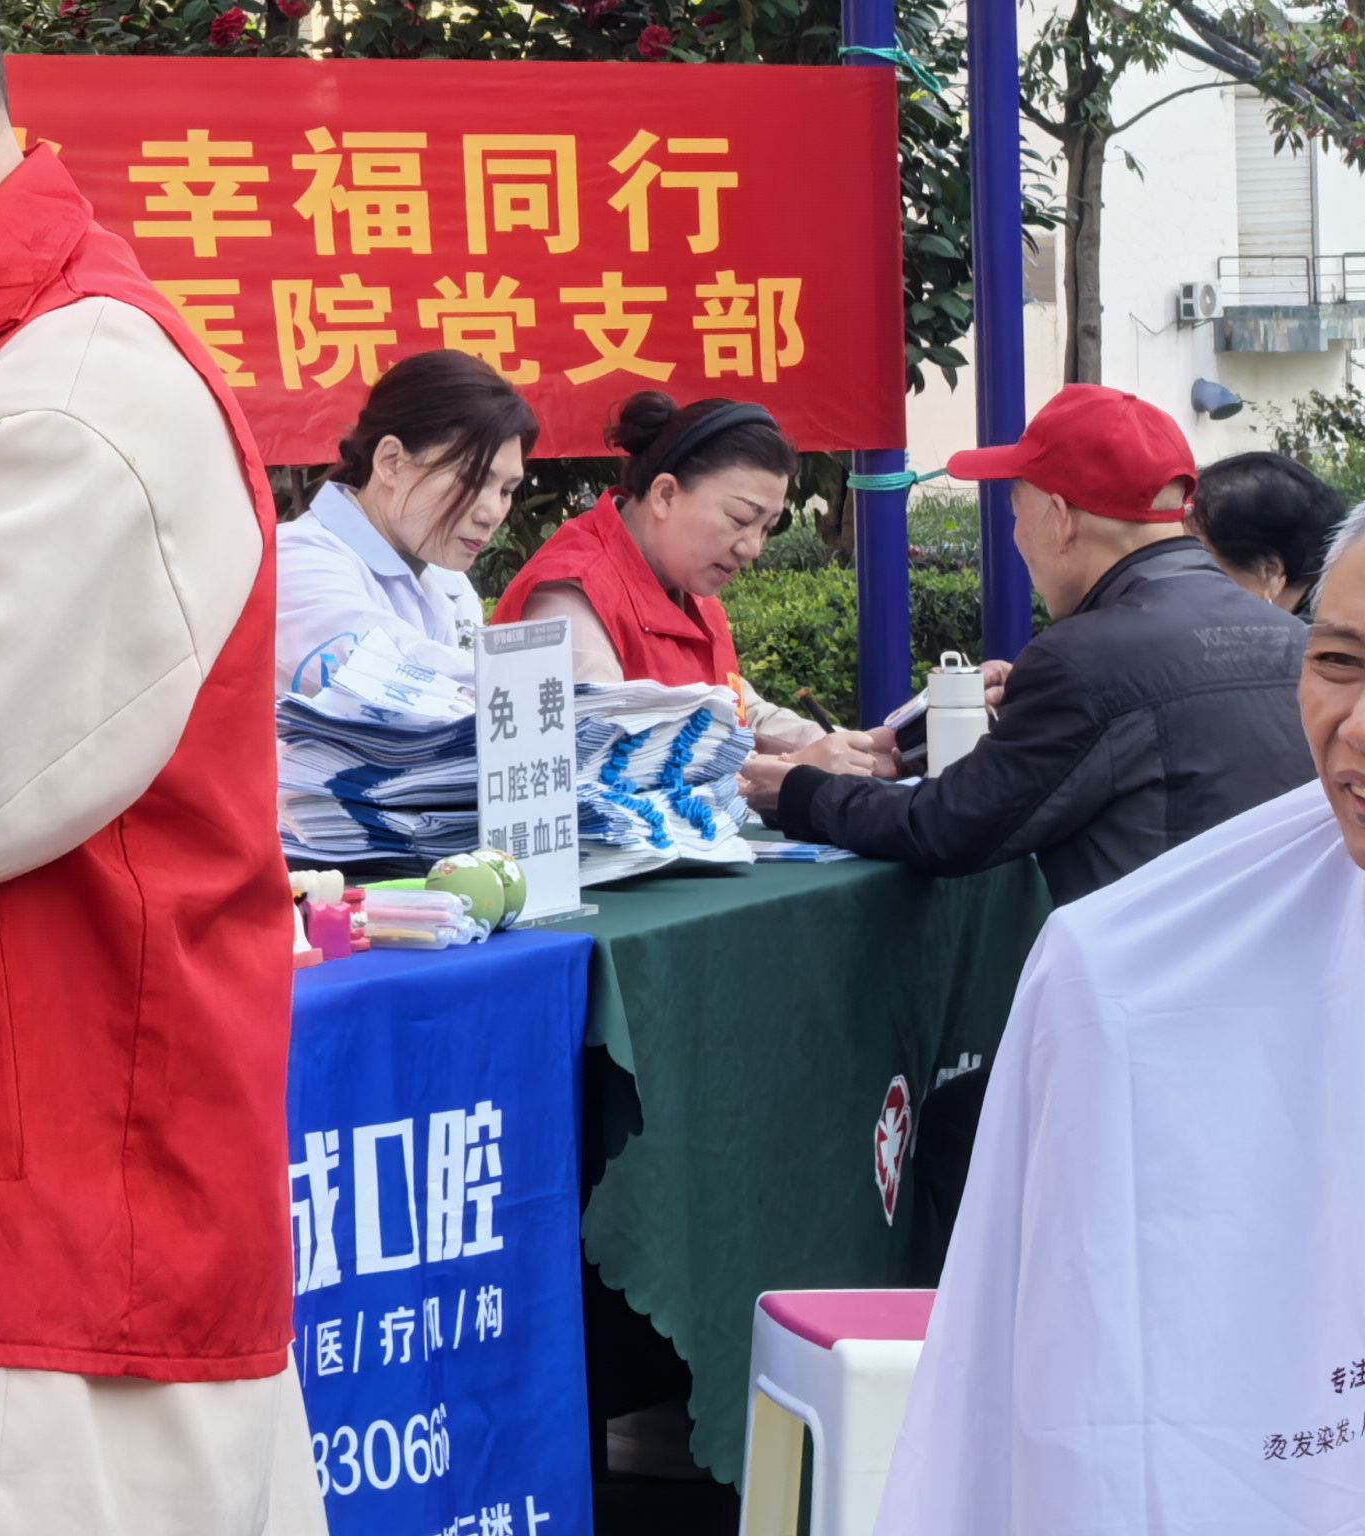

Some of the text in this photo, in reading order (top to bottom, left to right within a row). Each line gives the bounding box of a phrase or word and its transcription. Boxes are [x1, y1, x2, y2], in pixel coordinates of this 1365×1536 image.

[127, 126, 739, 257] 幸福同行
[487, 755, 571, 804] 口腔咨询
